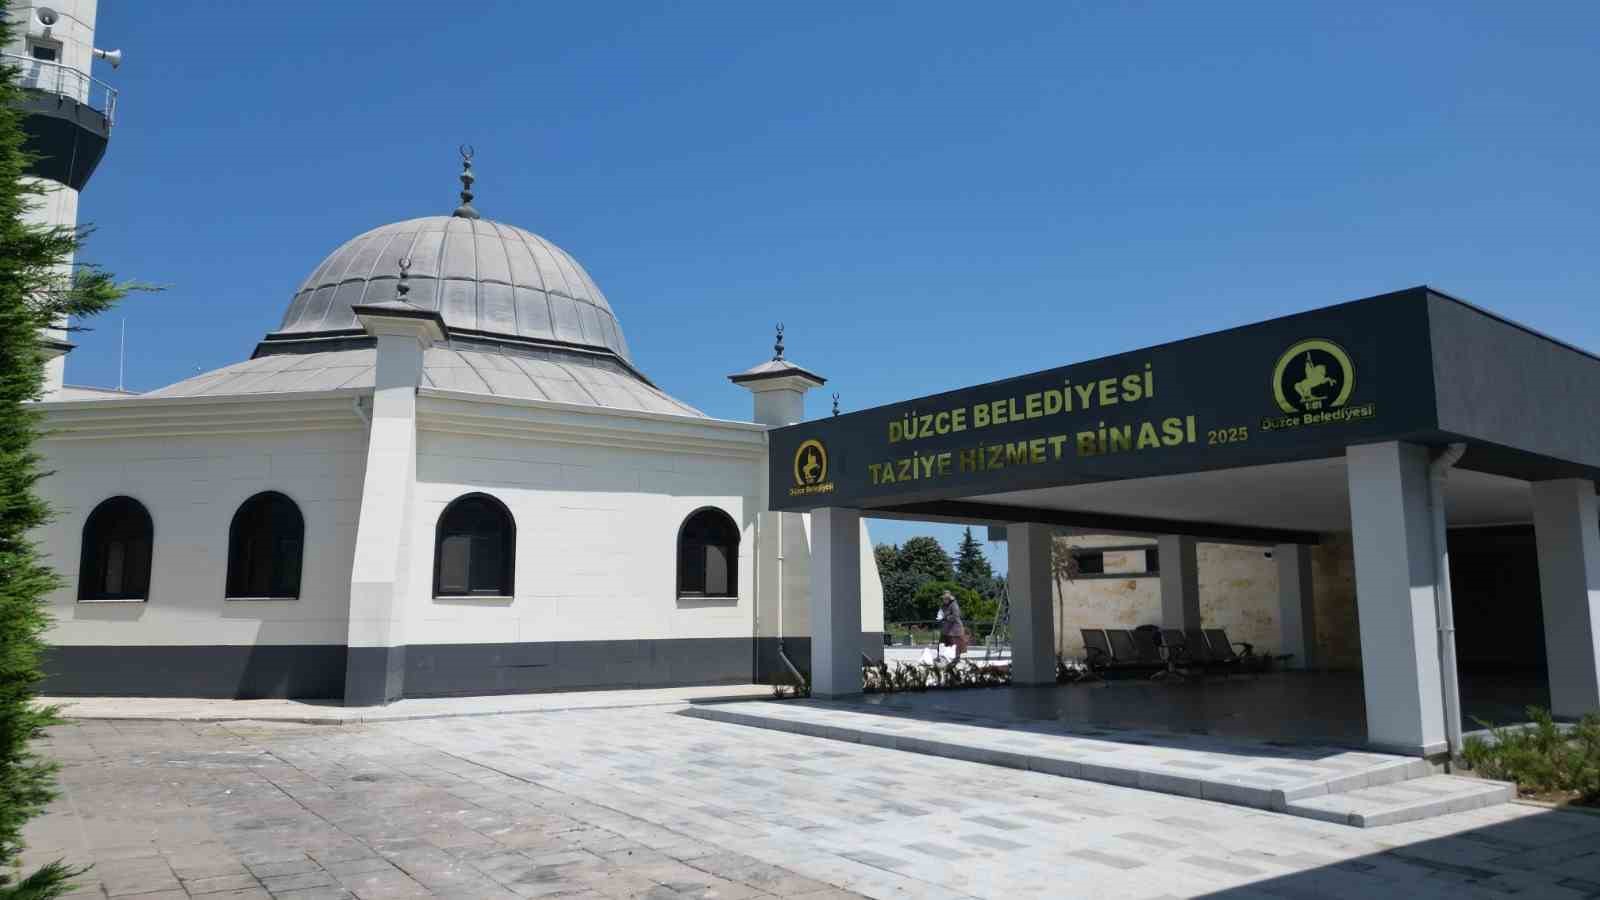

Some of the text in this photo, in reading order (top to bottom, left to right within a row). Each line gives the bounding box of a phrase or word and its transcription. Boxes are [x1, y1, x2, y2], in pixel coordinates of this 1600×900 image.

[887, 363, 1154, 444] DÜZCE BELEDİYESİ
[1208, 428, 1249, 446] 2025
[869, 415, 1197, 485] TAZİYE HİZMET BİNASI
